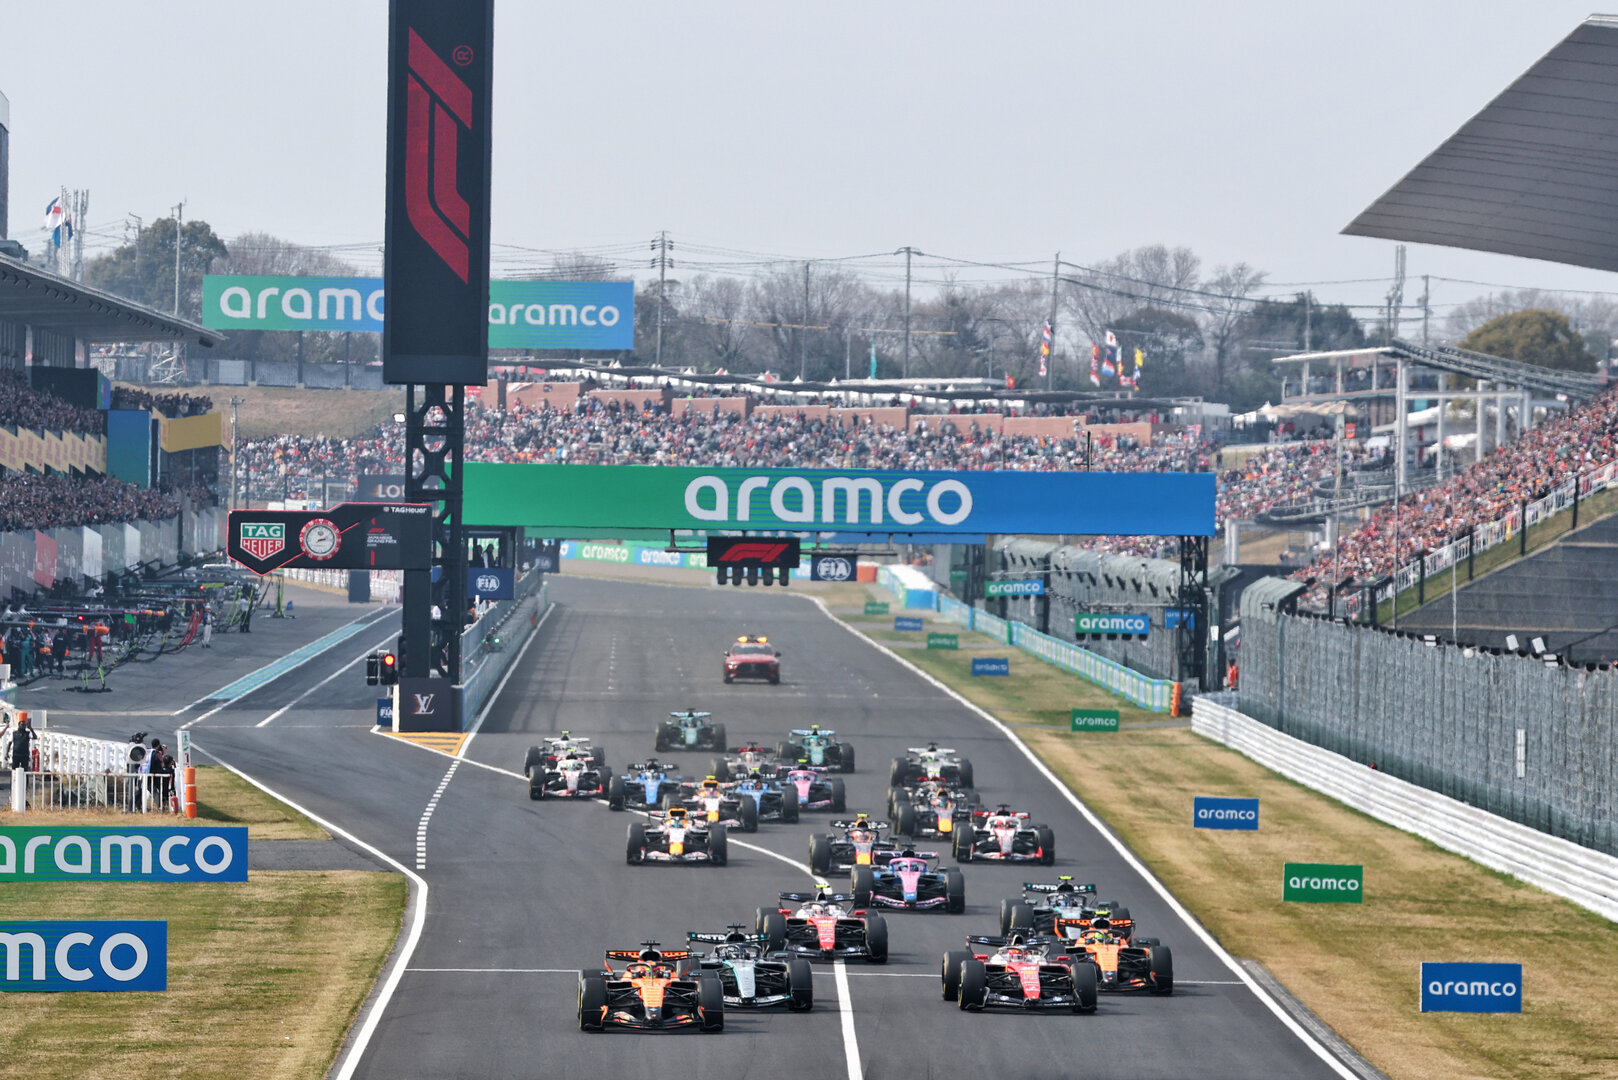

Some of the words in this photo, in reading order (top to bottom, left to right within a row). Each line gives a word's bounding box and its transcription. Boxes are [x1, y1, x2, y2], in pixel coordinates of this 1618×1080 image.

[220, 286, 384, 321] aramc
[488, 303, 620, 327] aramco
[684, 475, 973, 526] aramco
[244, 526, 281, 537] TAG
[243, 540, 282, 557] HEUER
[582, 545, 629, 562] aramco
[641, 550, 681, 565] aramco
[689, 553, 707, 567] ara
[819, 561, 849, 576] FIA
[989, 582, 1041, 594] aramco
[1079, 617, 1145, 630] aramco
[1075, 717, 1117, 726] aramco
[1198, 807, 1256, 821] aramco
[1289, 876, 1360, 891] aramco
[0, 932, 148, 982] mco
[1428, 980, 1517, 997] aramco
